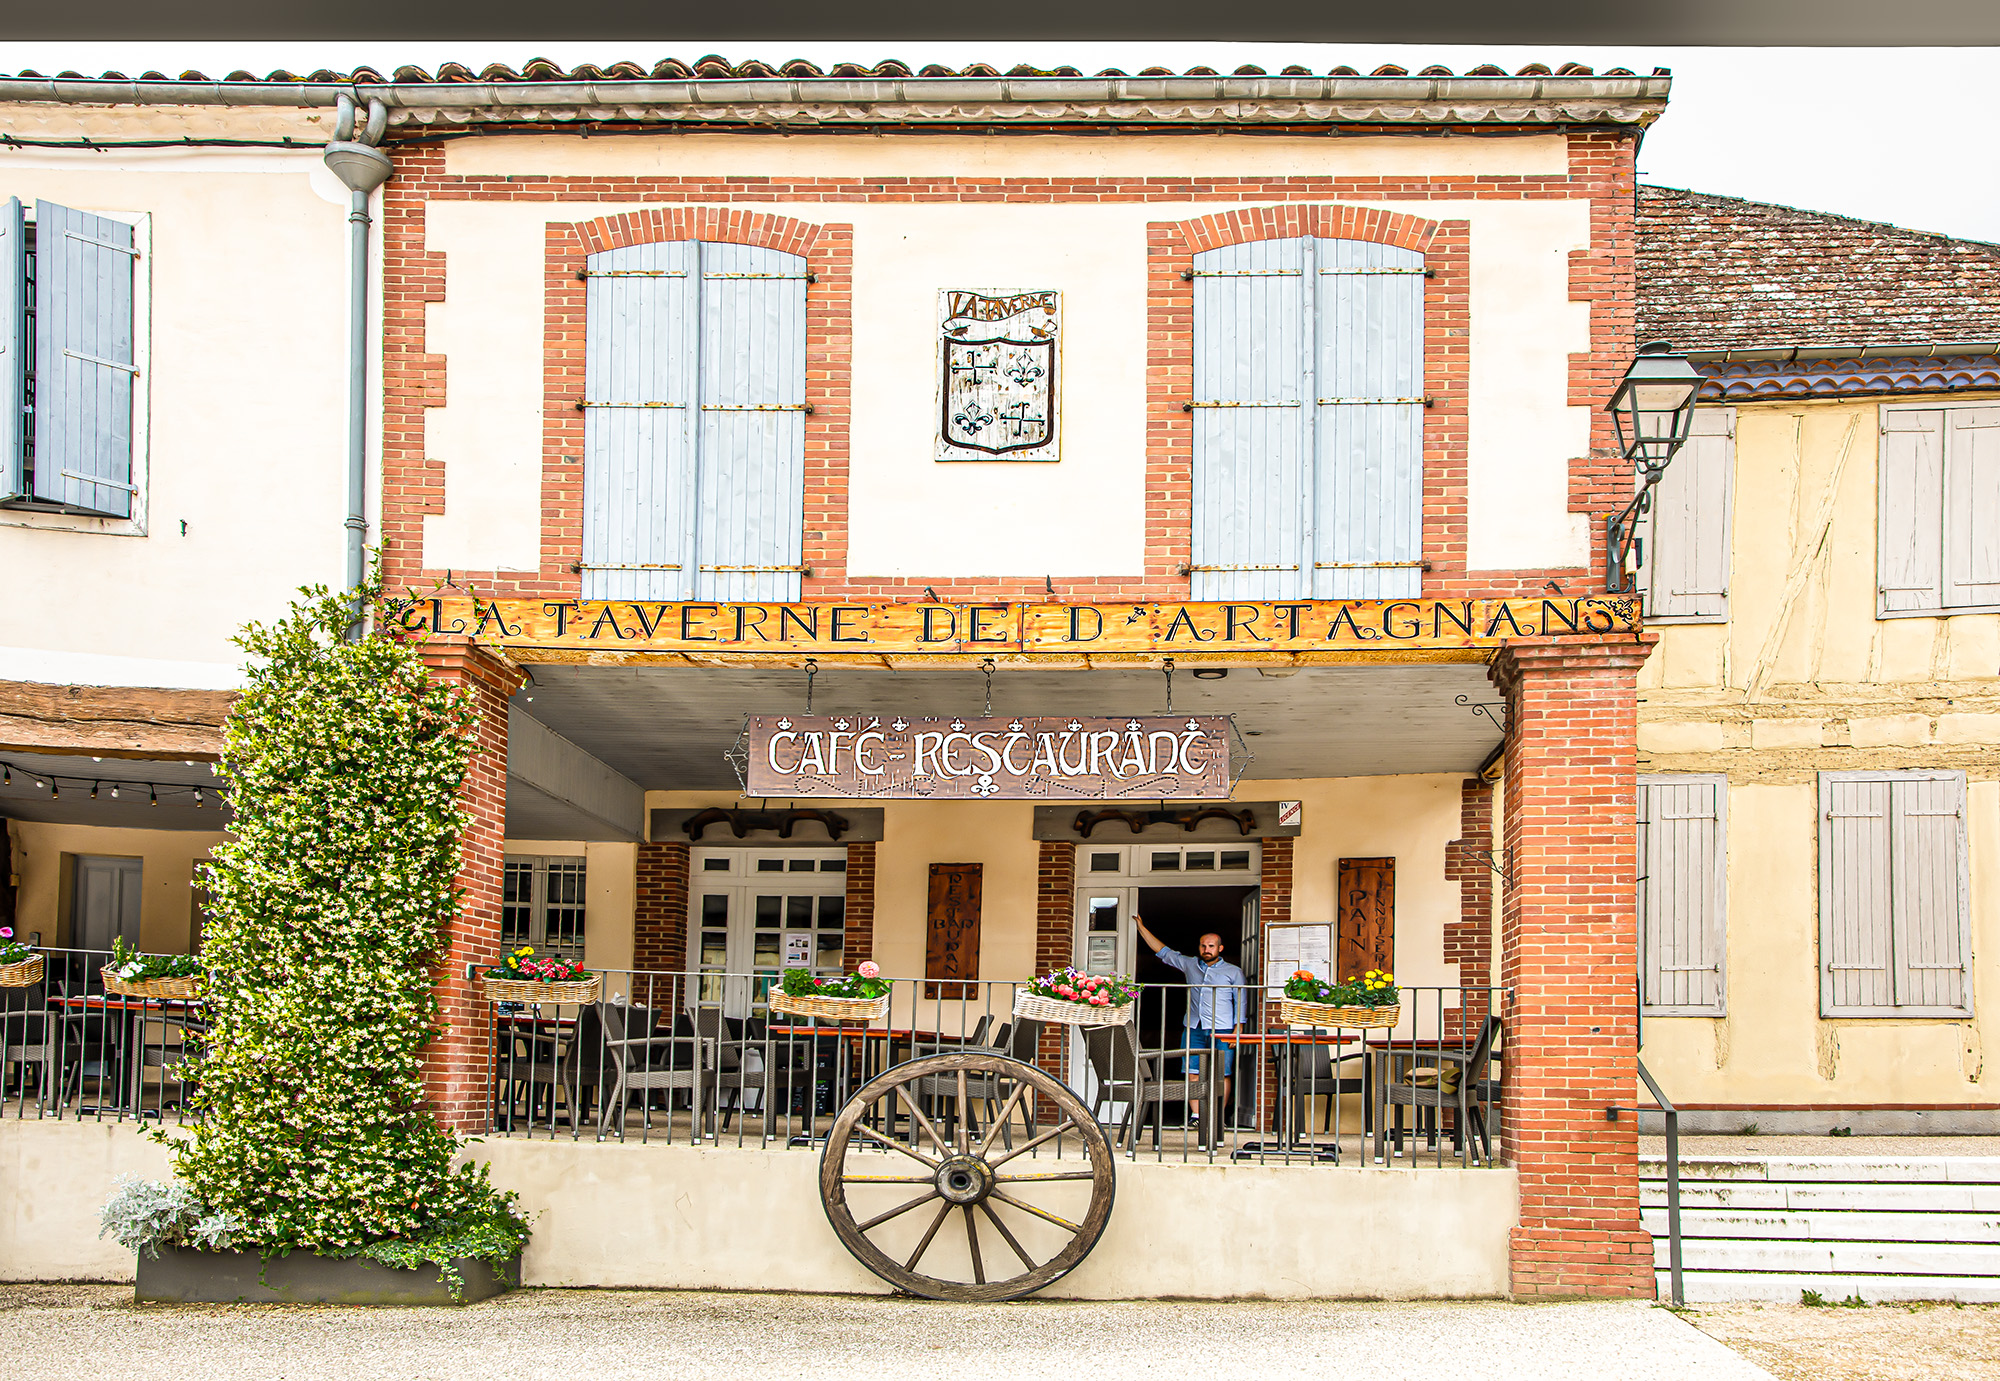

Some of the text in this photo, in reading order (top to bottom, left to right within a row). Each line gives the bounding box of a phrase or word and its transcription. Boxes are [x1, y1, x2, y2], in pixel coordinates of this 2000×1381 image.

[951, 293, 1053, 321] LA TAVERNE
[428, 599, 522, 637] LA
[543, 602, 869, 642] TAVERNE
[916, 606, 1008, 642] DE
[1279, 802, 1301, 824] LICENCE
[1349, 889, 1367, 952] PAIN
[1375, 871, 1386, 971] VIENNOISERI
